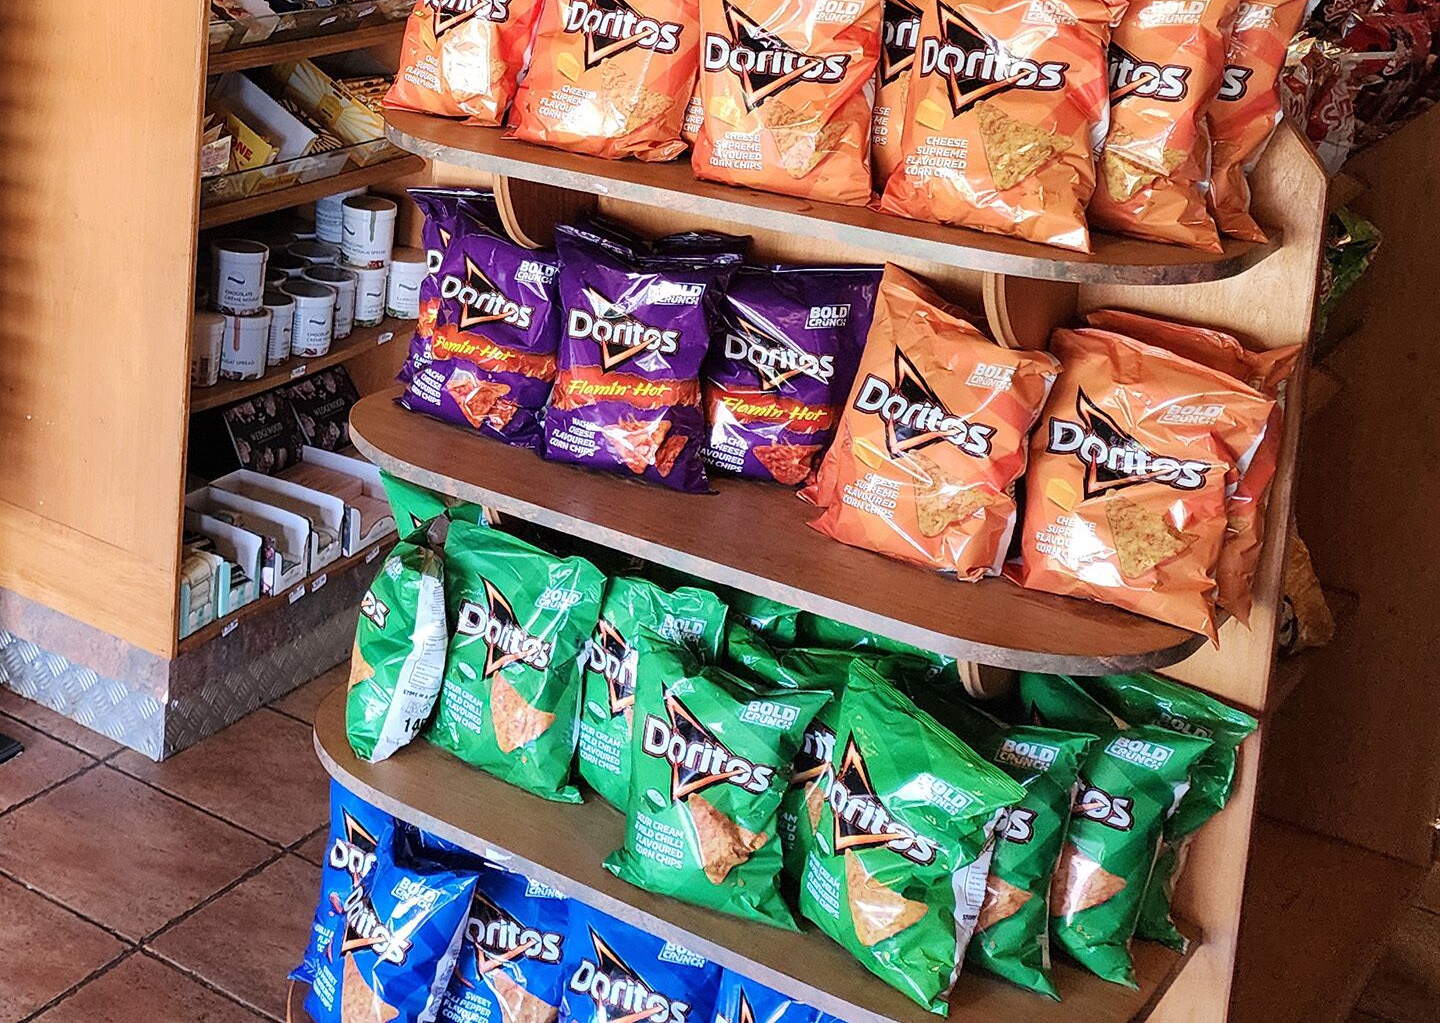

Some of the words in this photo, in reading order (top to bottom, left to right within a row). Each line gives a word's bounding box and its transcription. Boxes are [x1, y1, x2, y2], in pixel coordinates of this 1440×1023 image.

[815, 0, 861, 15] BOLD
[704, 32, 852, 84] Doritos
[920, 36, 1071, 92] Doritos
[714, 139, 761, 152] SUPREME
[724, 131, 761, 143] CHEESE
[925, 136, 969, 149] CHEESE
[915, 146, 968, 159] SUPREME
[734, 159, 763, 171] CHIPS
[904, 166, 933, 177] CORN
[905, 157, 968, 170] FLAVOURED
[520, 260, 558, 278] BOLD
[441, 275, 534, 330] Doritos
[809, 305, 849, 319] BOLD
[568, 308, 683, 355] Doritos
[808, 317, 848, 328] CRUNCH
[480, 345, 516, 363] Hot
[723, 332, 836, 379] Doritos
[420, 373, 442, 391] CHEESE
[632, 381, 673, 398] Hot
[313, 397, 346, 417] WEDGEWOOD
[422, 391, 442, 407] CHIPS
[789, 405, 828, 423] Hot
[852, 372, 998, 459] Doritos
[1166, 404, 1224, 418] BOLD
[551, 429, 597, 448] FLAVOURED
[568, 426, 597, 439] CHEESE
[549, 437, 569, 451] CORN
[569, 441, 596, 458] CHIPS
[710, 442, 747, 458] CHEESE
[1045, 416, 1213, 491] Doritos
[715, 460, 744, 474] CHIPS
[843, 485, 898, 510] FLAVOURED
[854, 479, 901, 499] SUPREME
[842, 496, 867, 511] CORN
[663, 614, 706, 634] BOLD
[457, 598, 553, 672] Doritos
[459, 686, 483, 708] CREAM
[444, 697, 482, 725] FLAVOURED
[461, 698, 483, 717] CHILLI
[747, 700, 798, 721] BOLD
[460, 716, 481, 735] CHIPS
[595, 728, 622, 748] CREAM
[597, 738, 621, 758] CHILLI
[579, 740, 621, 766] FLAVOURED
[641, 712, 776, 797] Doritos
[1004, 739, 1057, 764] BOLD
[1112, 746, 1163, 771] CRUNCH
[1119, 736, 1169, 762] BOLD
[579, 750, 598, 765] CORN
[597, 757, 621, 776] CHIPS
[998, 751, 1051, 772] CRUNCH
[652, 819, 685, 840] CREAM
[635, 833, 685, 859] FLAVOURED
[653, 830, 685, 850] CHILLI
[654, 852, 684, 871] CHIPS
[663, 950, 706, 969] CRUNCH
[465, 991, 492, 1007] SWEET
[568, 958, 693, 1023] Doritos
[460, 998, 492, 1018] PEPPER
